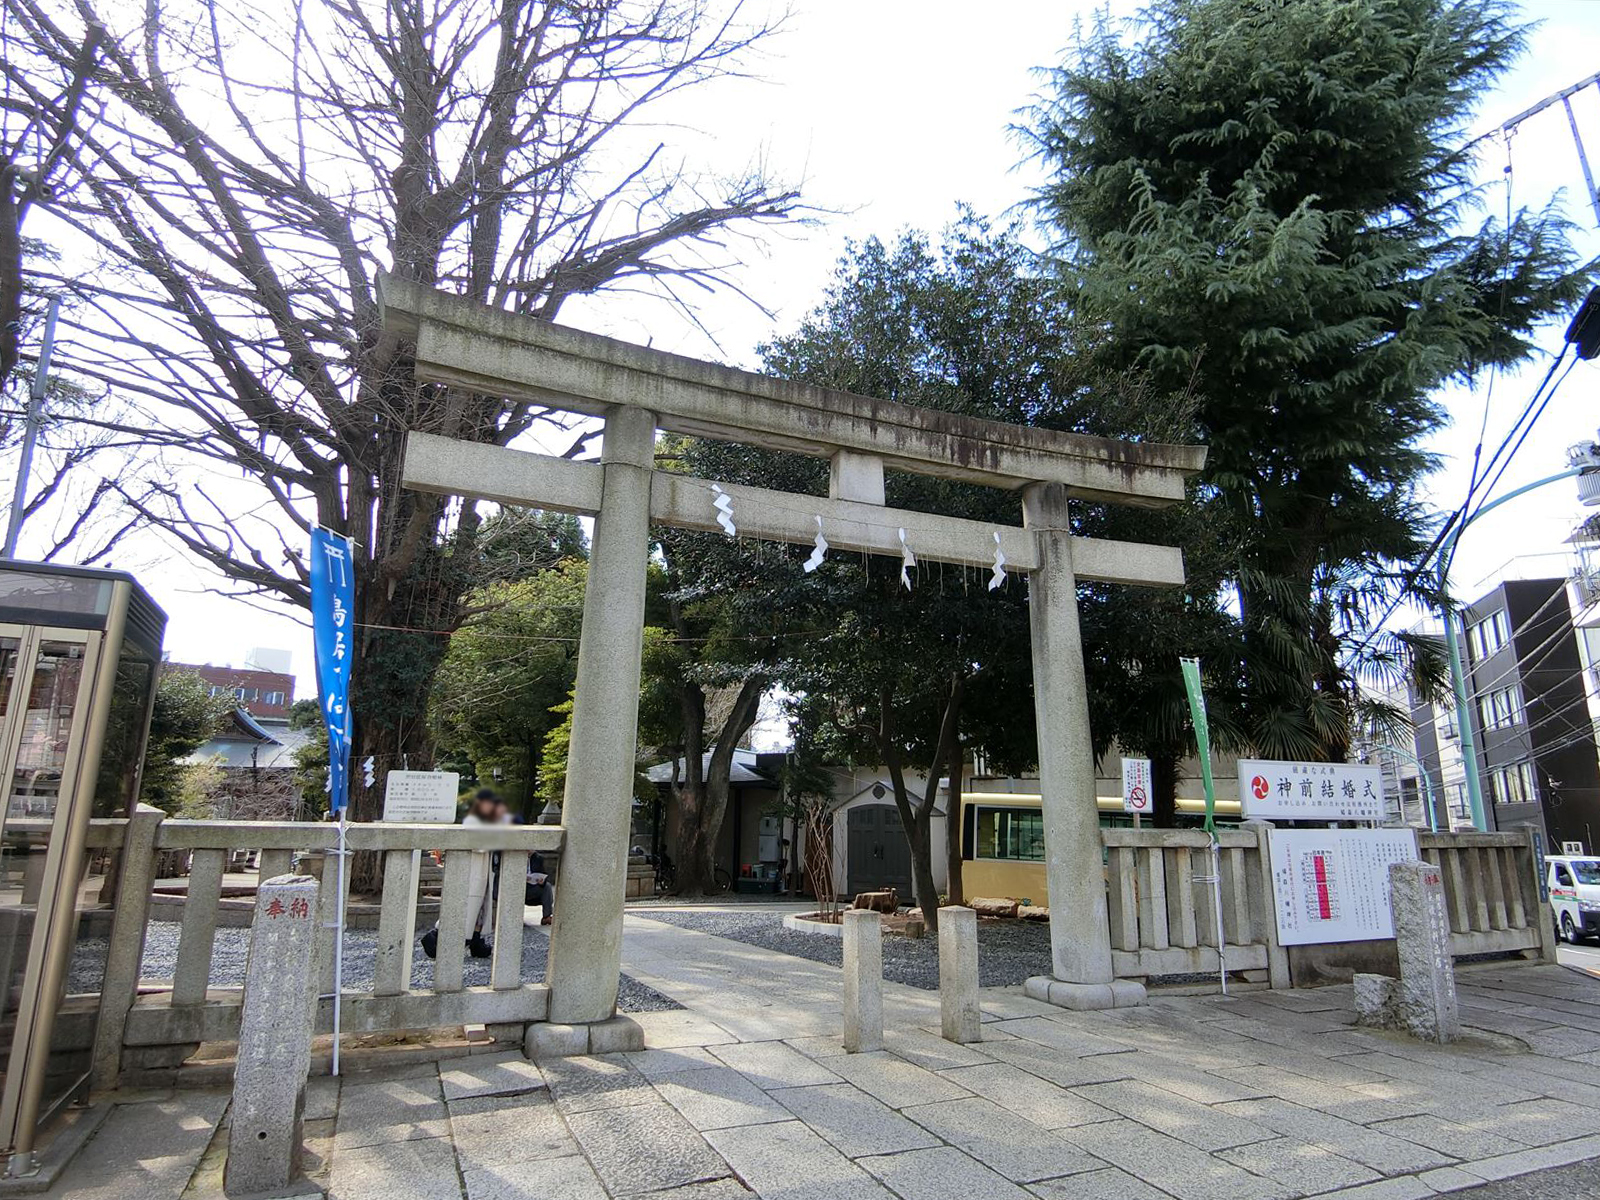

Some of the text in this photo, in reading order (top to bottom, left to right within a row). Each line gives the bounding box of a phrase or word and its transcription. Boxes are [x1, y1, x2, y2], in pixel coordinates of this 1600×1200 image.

[1277, 777, 1377, 800] 神前結婚式
[265, 897, 309, 919] 奉納
